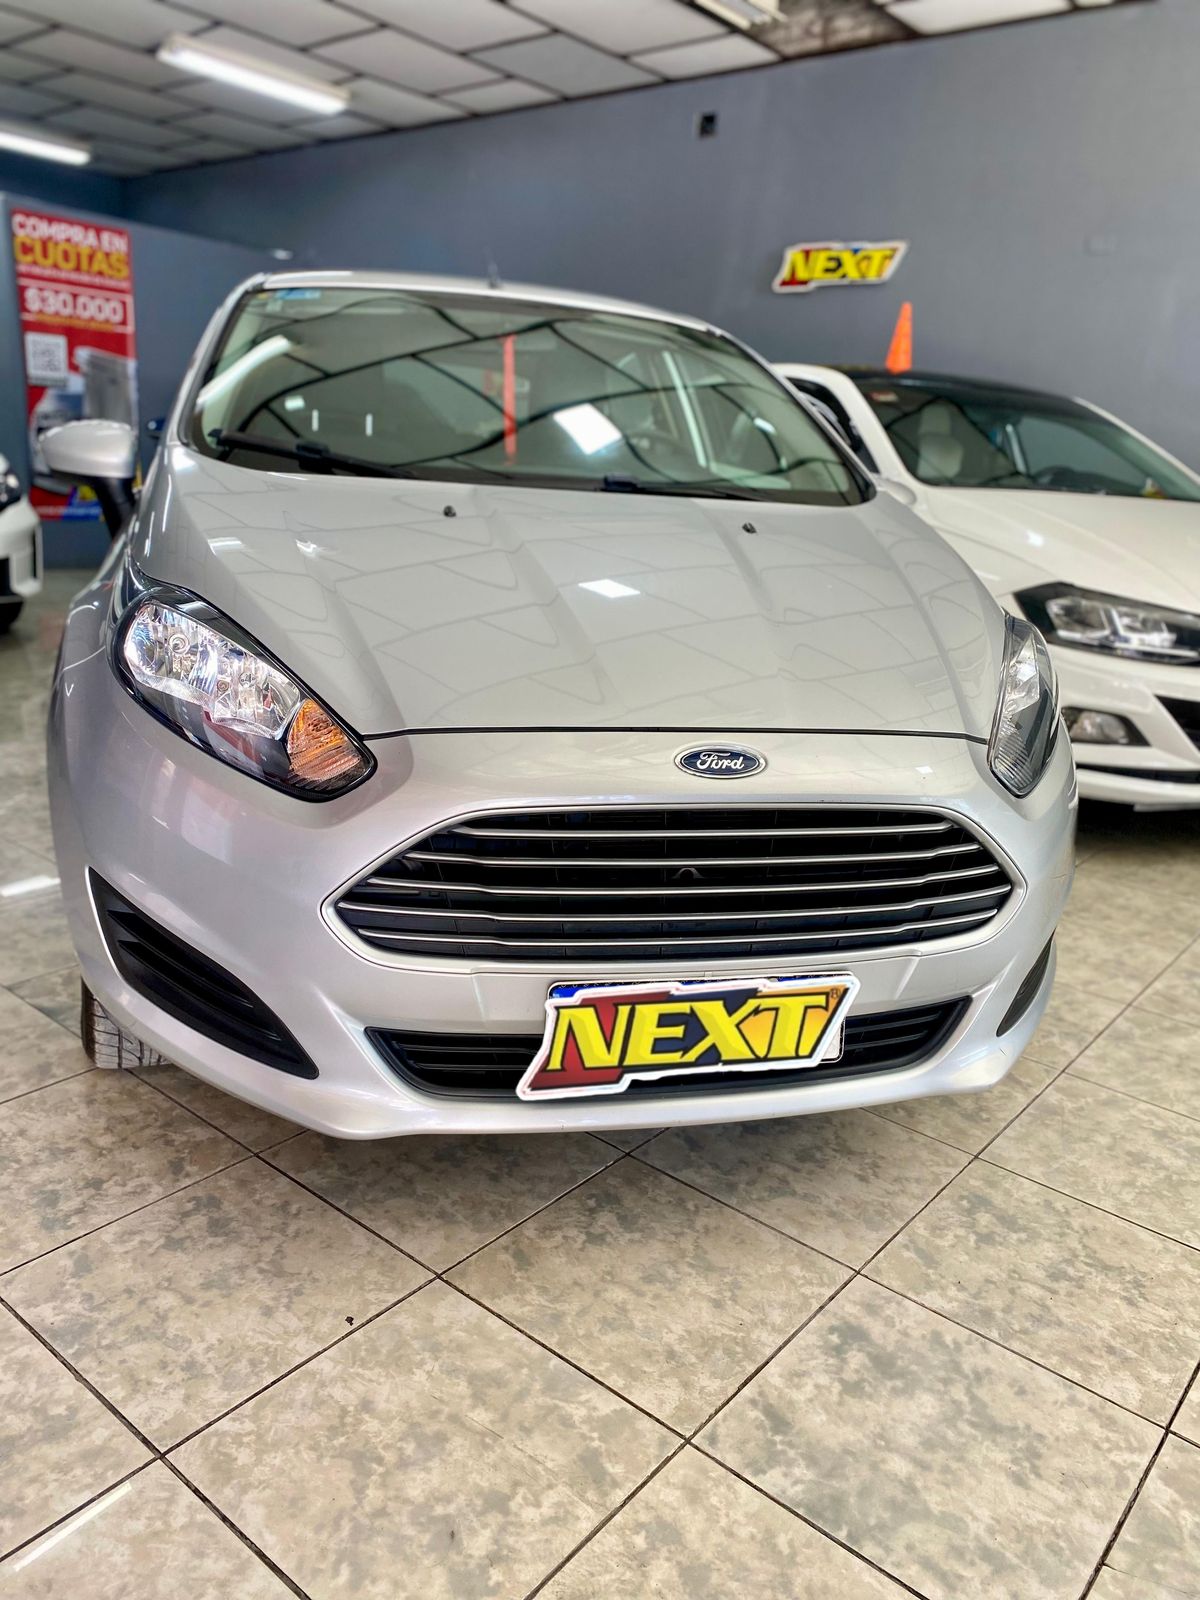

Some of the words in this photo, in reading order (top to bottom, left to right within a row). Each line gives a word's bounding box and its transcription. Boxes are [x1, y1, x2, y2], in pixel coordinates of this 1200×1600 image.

[12, 213, 99, 249] COMPRA
[100, 229, 129, 253] EN
[14, 235, 129, 280] CUOTAS
[783, 248, 895, 282] NEXT
[697, 752, 744, 769] Ford
